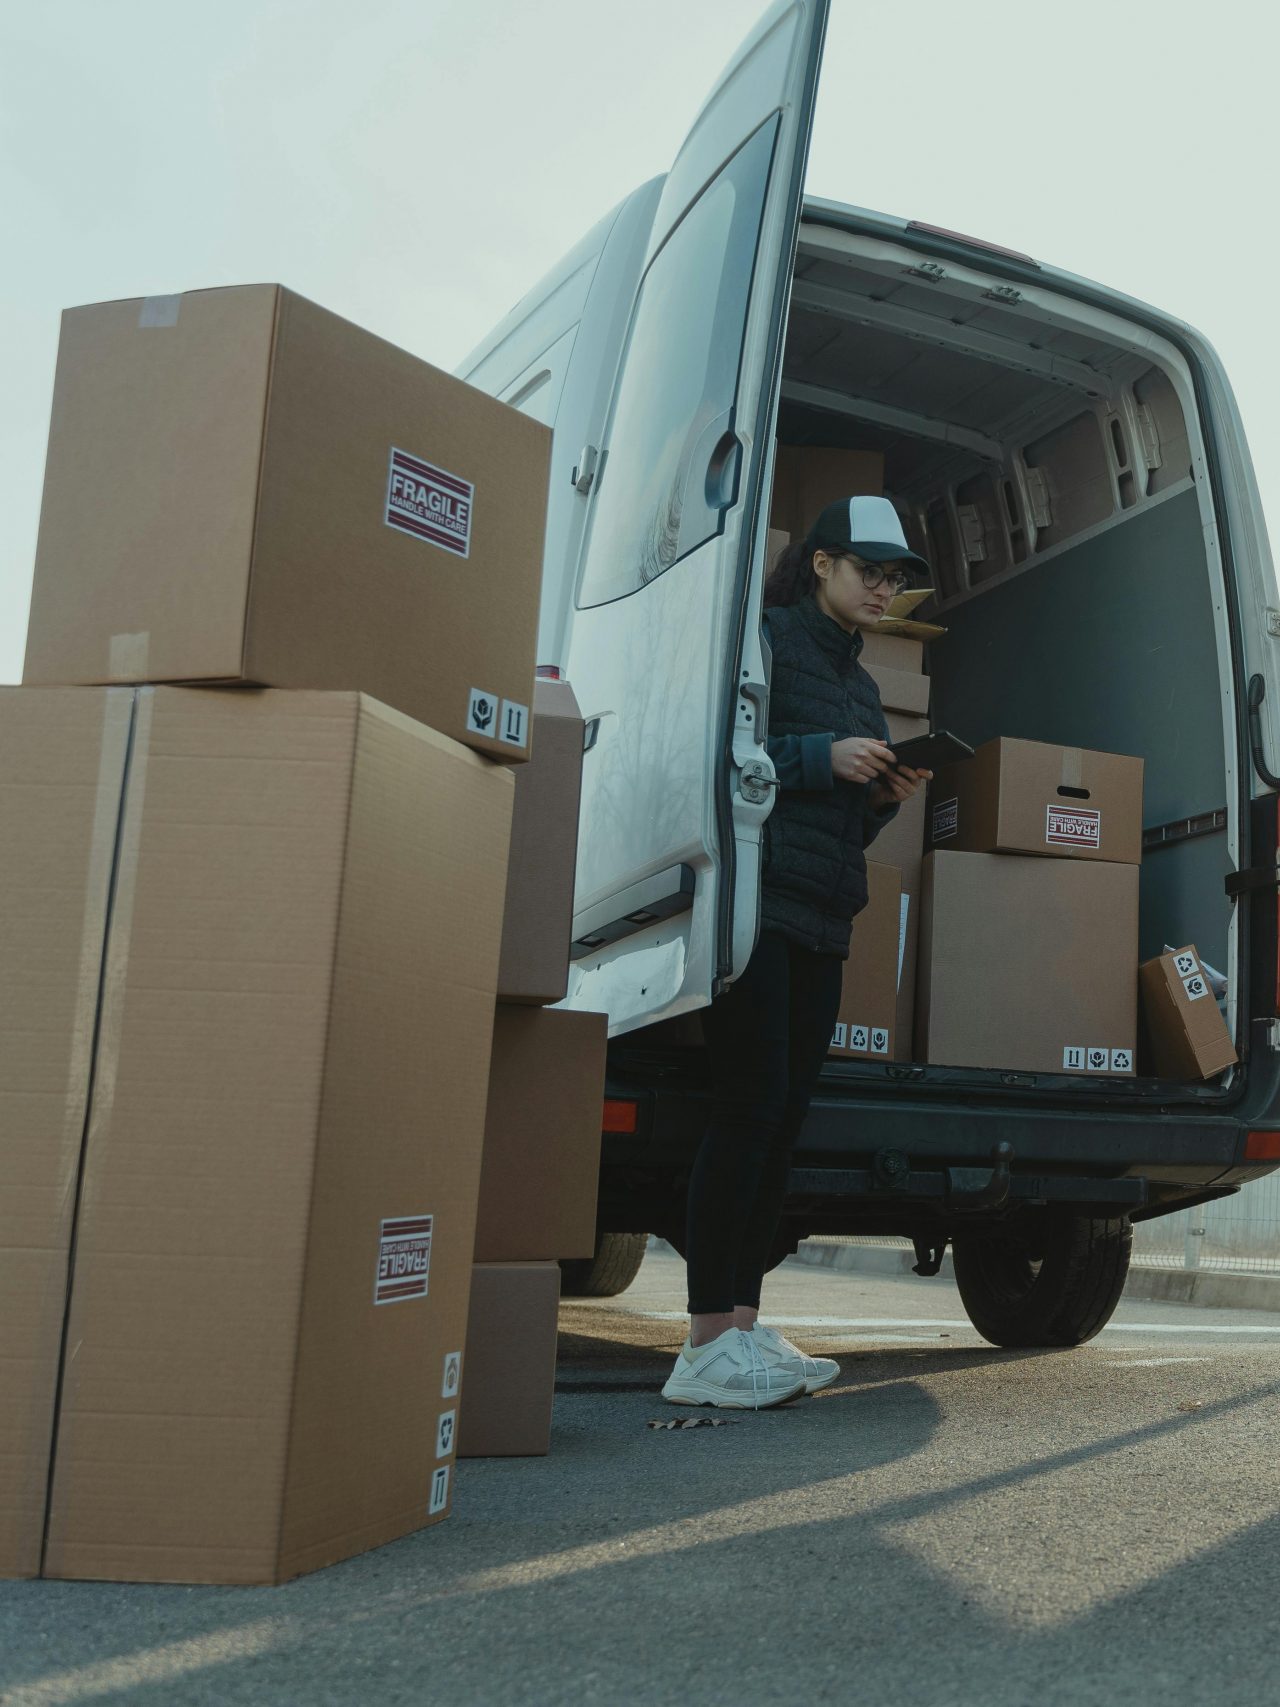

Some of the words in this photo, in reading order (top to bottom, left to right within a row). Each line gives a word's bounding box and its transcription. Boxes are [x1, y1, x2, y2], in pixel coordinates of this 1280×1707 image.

[391, 495, 424, 515] HANDLE
[425, 508, 445, 525] WITH
[445, 518, 467, 534] CARE
[392, 474, 468, 525] FRAGILE
[1050, 821, 1098, 836] FRAGILE
[380, 1249, 429, 1277] FRAGILE
